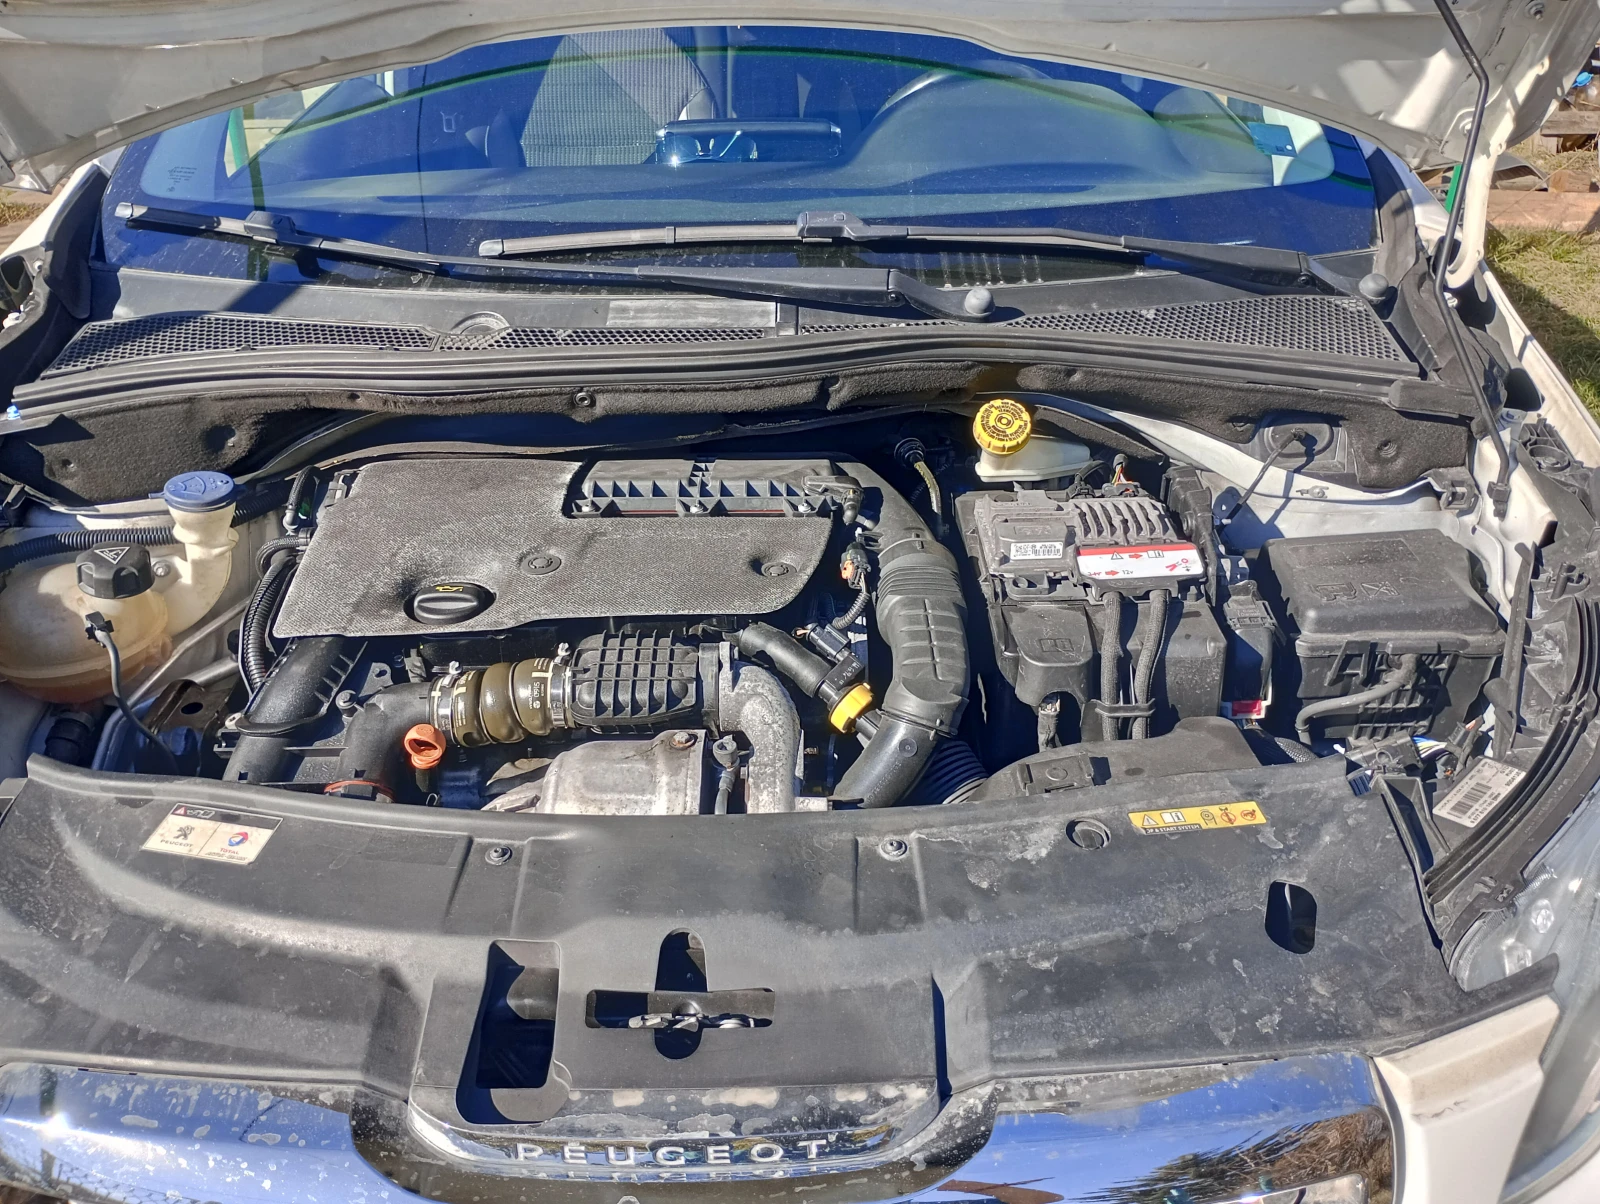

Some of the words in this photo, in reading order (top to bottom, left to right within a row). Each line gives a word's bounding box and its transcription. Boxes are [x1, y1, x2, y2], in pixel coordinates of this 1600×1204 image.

[160, 839, 193, 847] PEUGEOT
[220, 847, 240, 855] TOTAL
[515, 1139, 828, 1166] PEUGEOT
